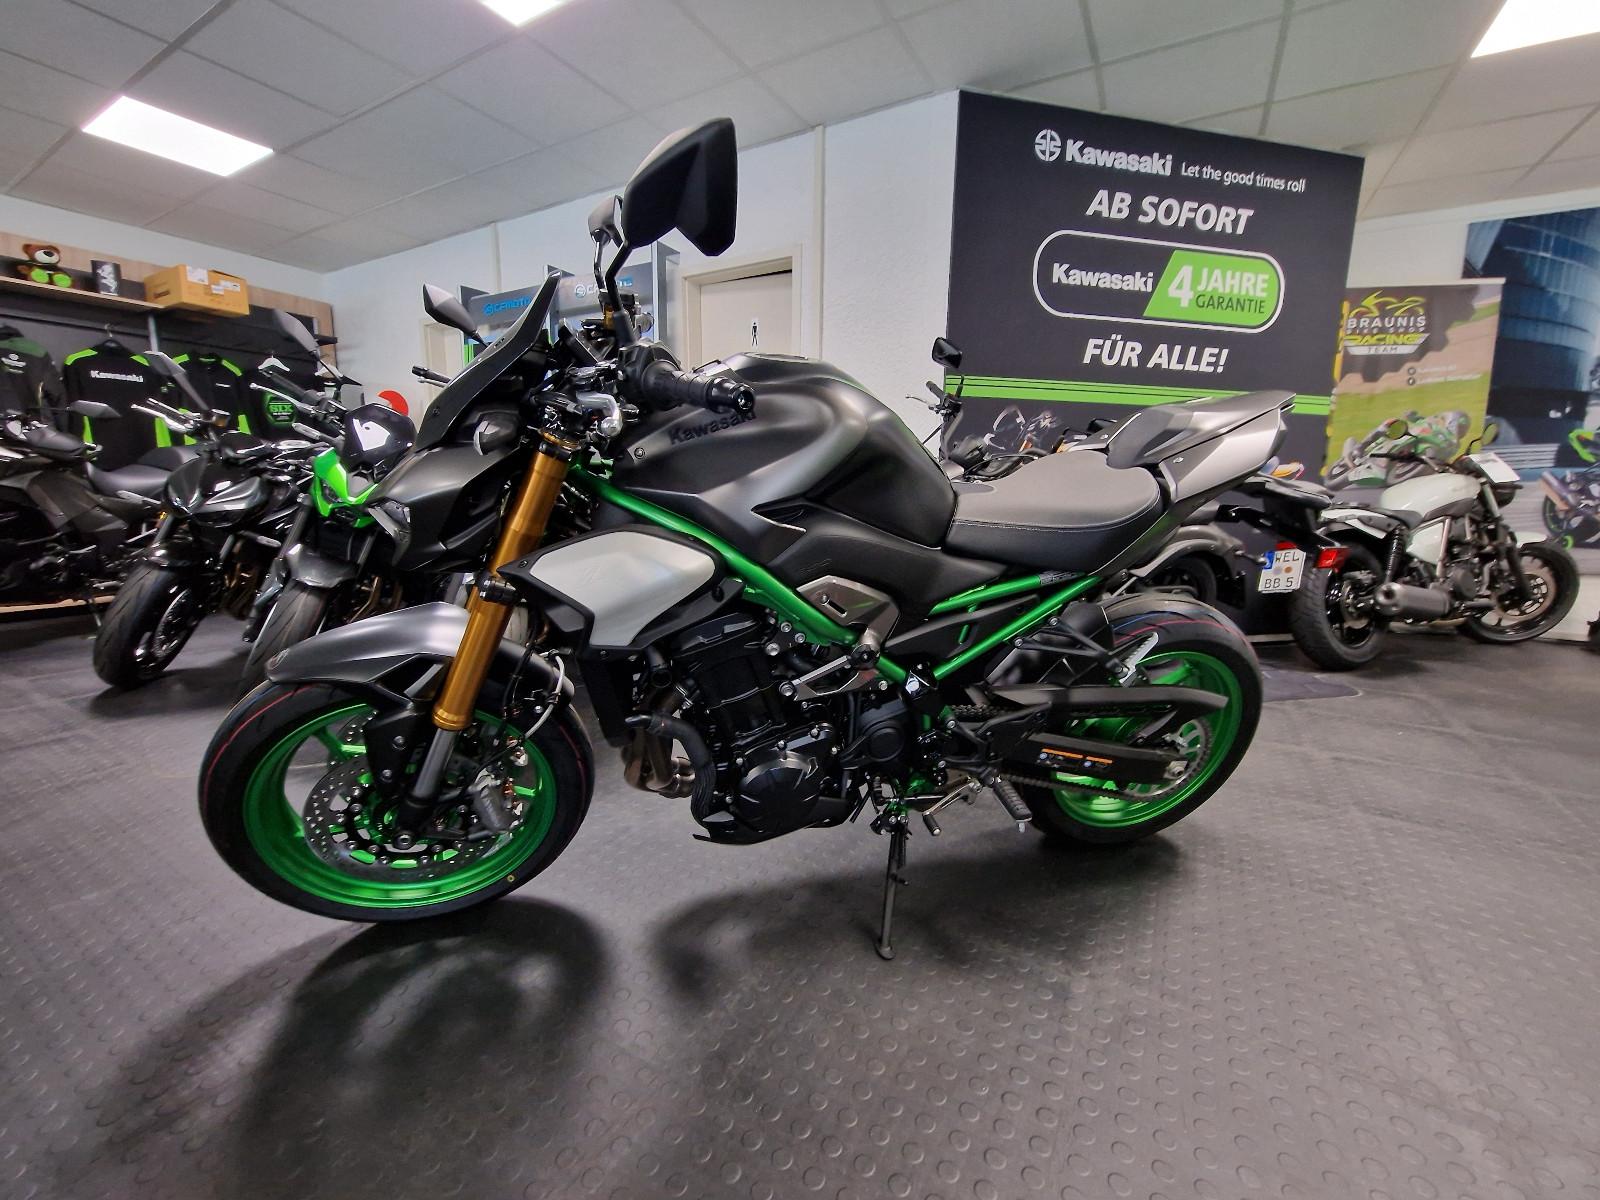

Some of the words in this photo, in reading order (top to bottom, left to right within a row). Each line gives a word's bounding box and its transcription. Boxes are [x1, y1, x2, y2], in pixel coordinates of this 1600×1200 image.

[1065, 139, 1173, 176] Kawasaki
[1181, 162, 1201, 178] Let
[1202, 165, 1222, 180] the
[1223, 171, 1255, 185] good
[1256, 173, 1286, 189] times
[1286, 178, 1306, 193] roll
[1085, 189, 1132, 219] AB
[1138, 195, 1255, 235] SOFORT
[1052, 262, 1154, 292] Kawasaki
[1168, 264, 1194, 308] 4
[1197, 267, 1270, 297] JAHRE
[1195, 294, 1266, 314] GARANTIE
[1346, 315, 1427, 330] BRAUNIS
[1082, 333, 1143, 367] FÜR
[1147, 343, 1229, 374] ALLE!
[1367, 346, 1399, 354] TEAM
[1264, 578, 1281, 589] BB
